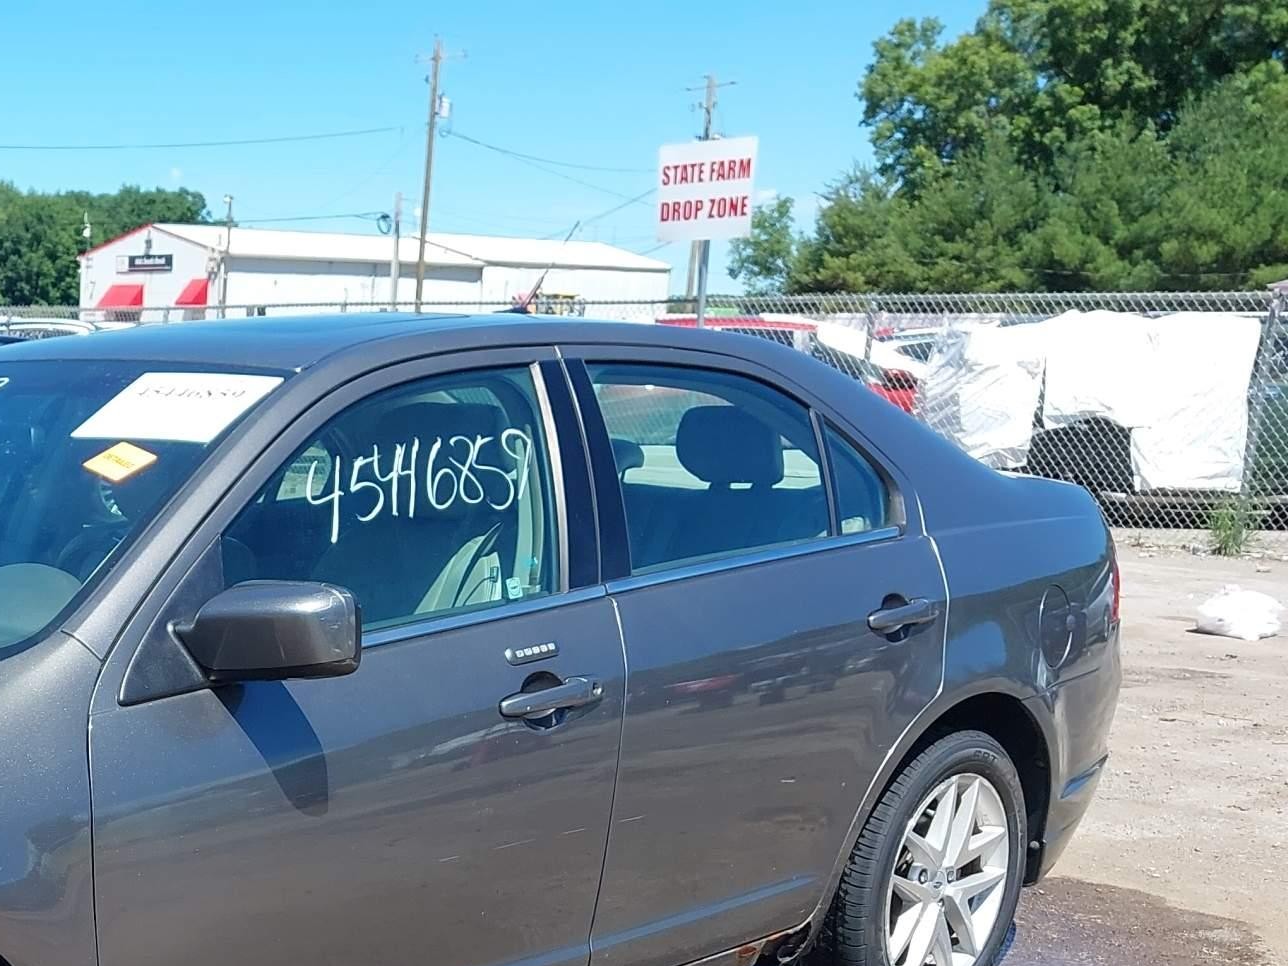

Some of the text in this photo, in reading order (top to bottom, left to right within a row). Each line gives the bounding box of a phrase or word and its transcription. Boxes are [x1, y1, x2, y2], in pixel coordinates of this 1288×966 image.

[662, 157, 752, 186] STATE FARM
[660, 195, 749, 222] DROP ZONE
[306, 427, 532, 543] 45446859
